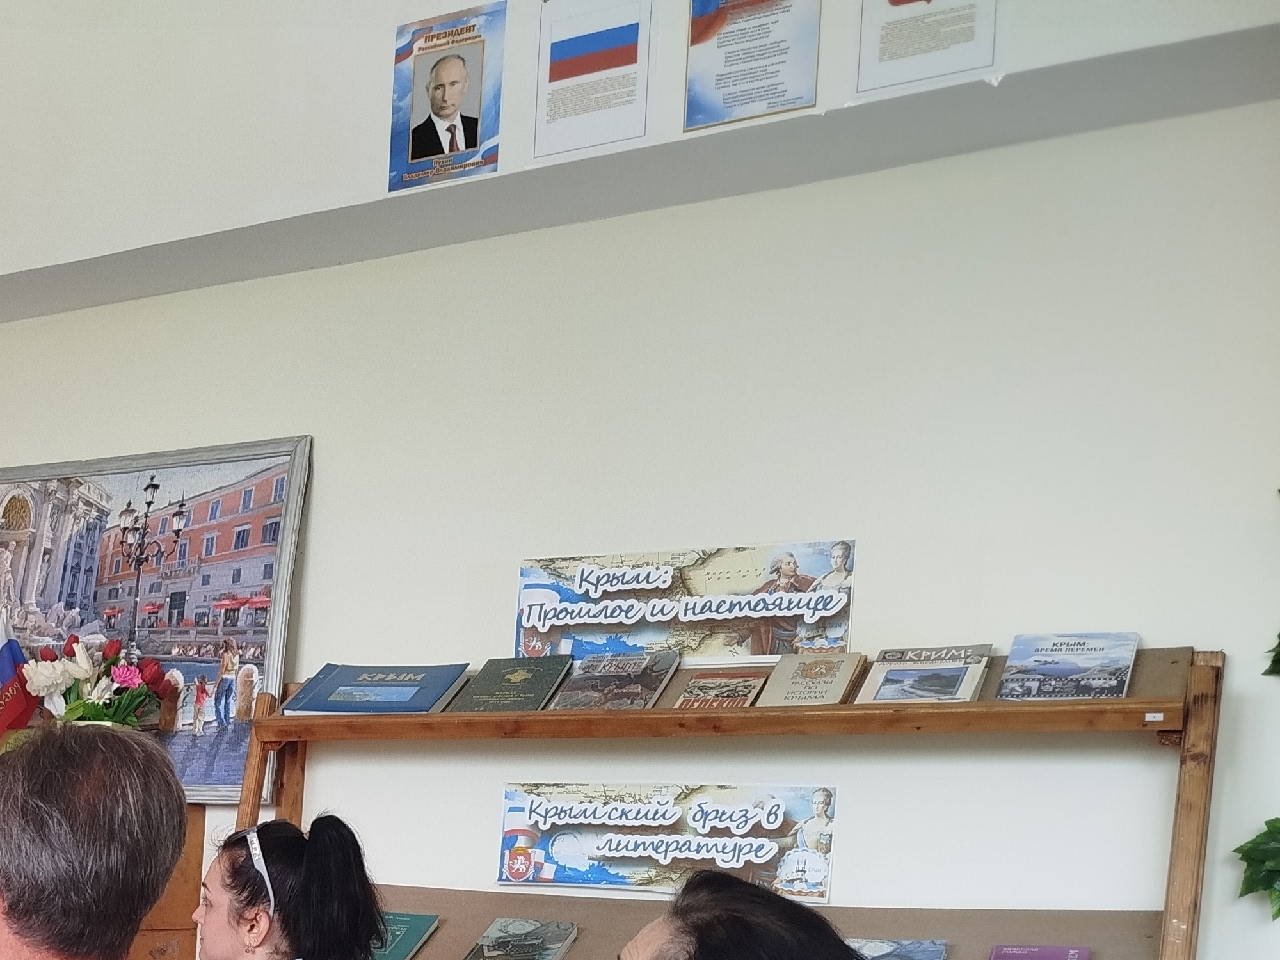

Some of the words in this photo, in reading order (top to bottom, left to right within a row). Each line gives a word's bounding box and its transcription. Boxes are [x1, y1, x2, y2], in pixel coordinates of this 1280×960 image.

[424, 24, 477, 43] ПРЕЗИДЕНТ
[578, 567, 670, 595] Крым:
[526, 602, 644, 629] Прошлое
[649, 602, 677, 622] и
[682, 591, 843, 623] настоящее
[905, 648, 973, 661] КРИМ:
[357, 672, 426, 682] КРЫМ
[528, 799, 678, 827] Крымский
[691, 801, 759, 831] бриз
[765, 802, 783, 825] в
[596, 840, 774, 864] литературе
